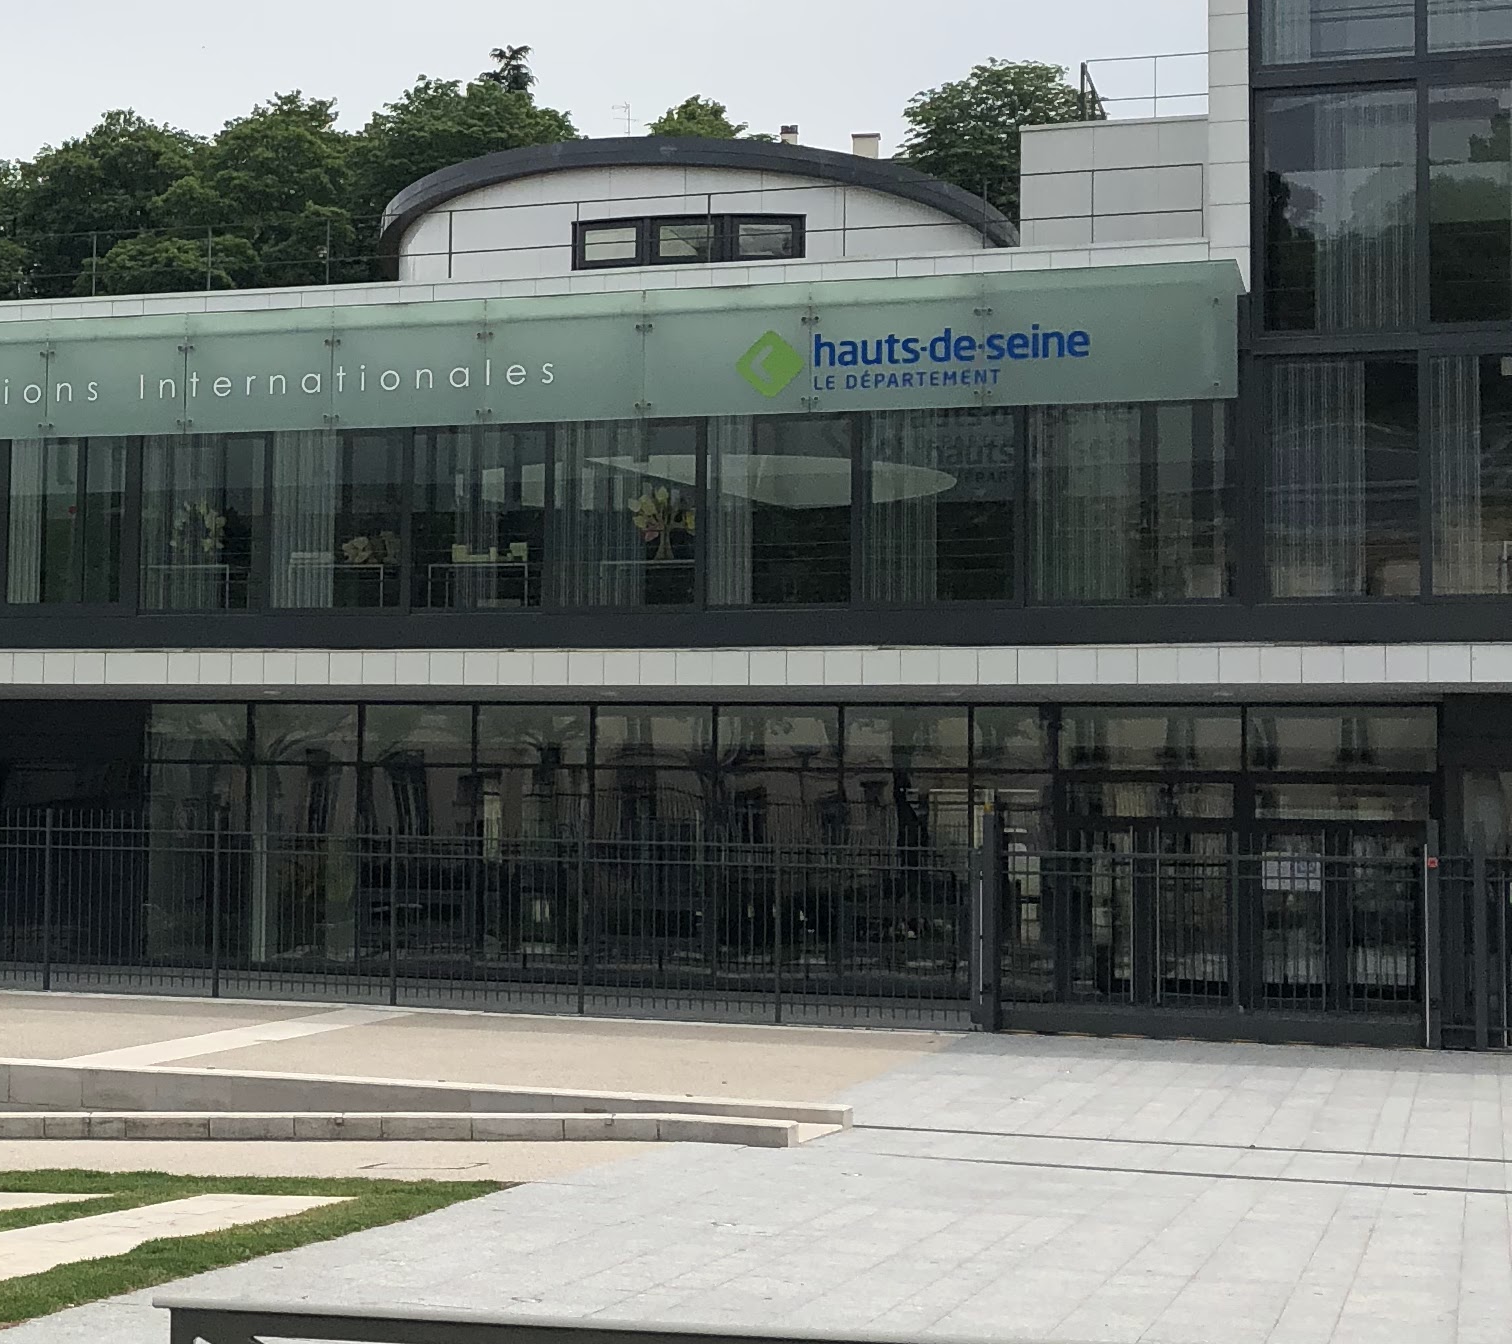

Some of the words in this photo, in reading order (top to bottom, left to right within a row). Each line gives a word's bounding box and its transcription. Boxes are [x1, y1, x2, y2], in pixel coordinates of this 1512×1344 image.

[139, 359, 555, 400] Internationales
[813, 375, 836, 391] LE
[846, 368, 1001, 390] DÉPARTEMENT
